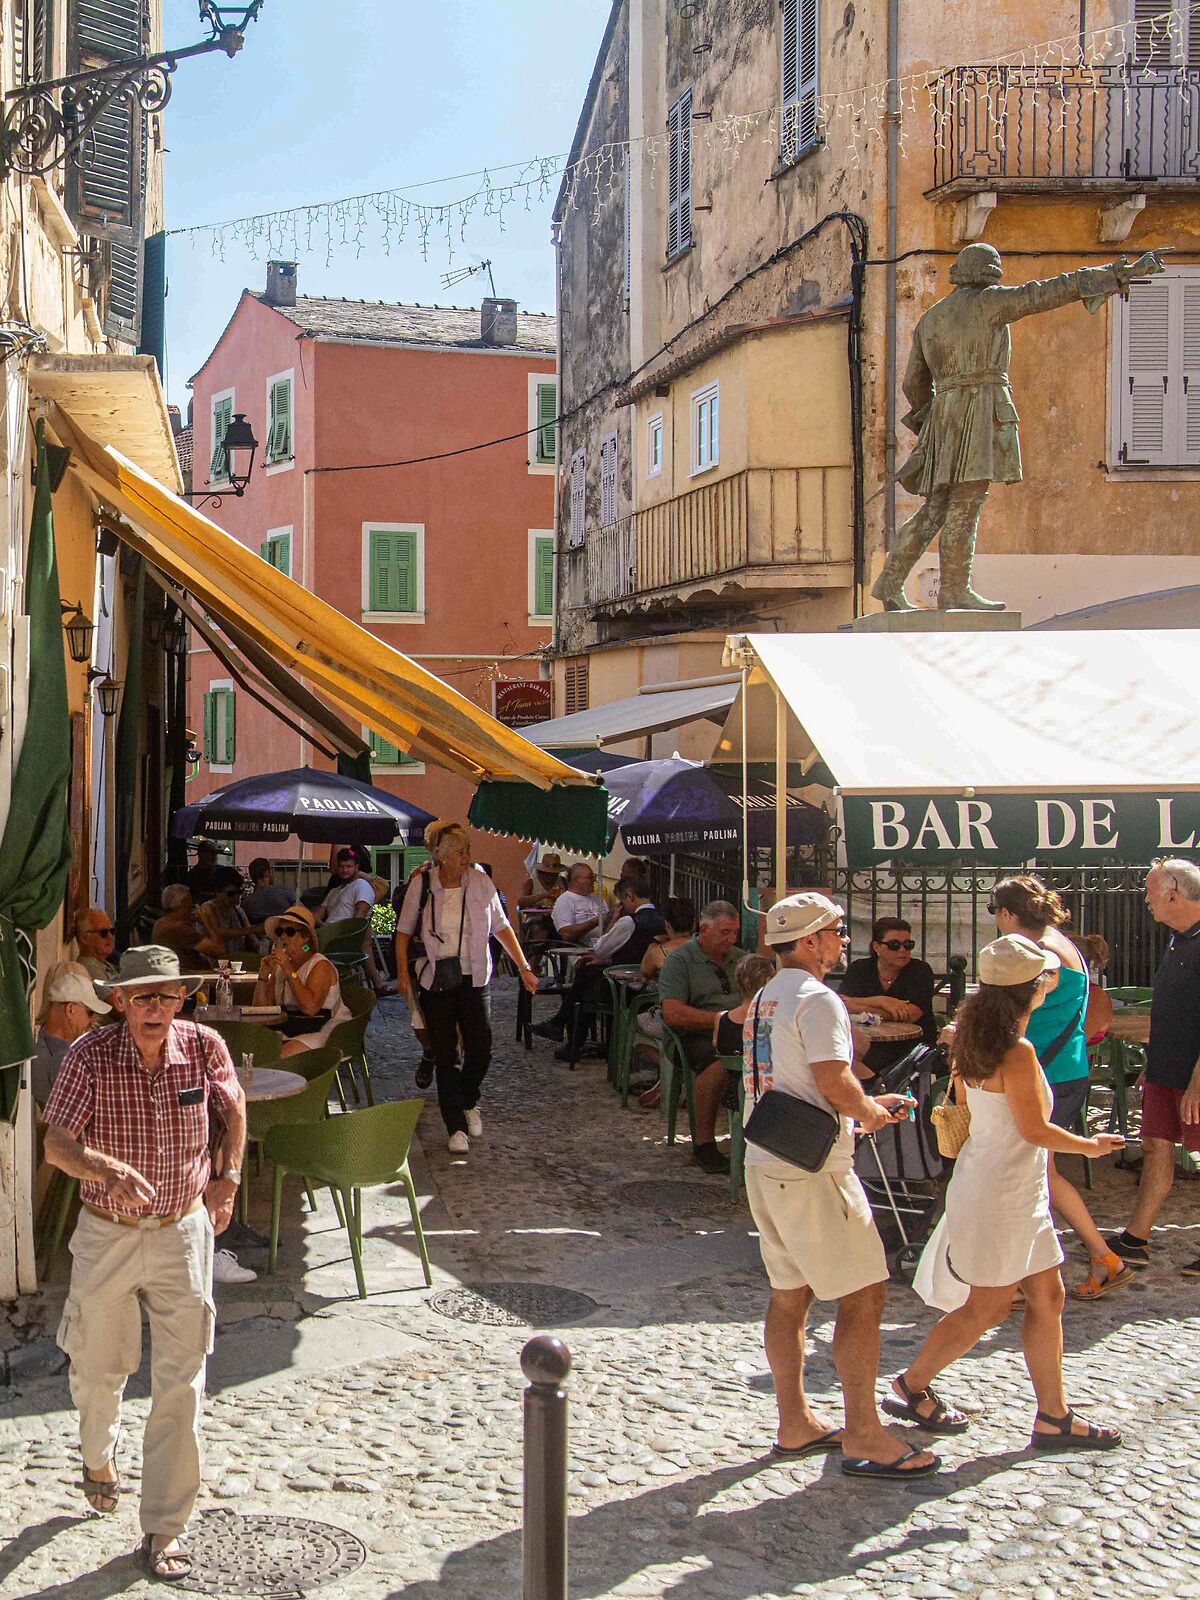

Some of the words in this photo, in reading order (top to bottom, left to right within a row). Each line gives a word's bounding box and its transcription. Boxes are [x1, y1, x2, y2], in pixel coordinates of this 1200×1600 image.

[300, 797, 379, 812] PAOLINA
[205, 822, 232, 831] PAOLINA
[262, 824, 289, 832] PAOLINA
[869, 800, 998, 850] BAR
[1034, 800, 1120, 850] DE
[1156, 798, 1200, 848] L
[627, 834, 660, 845] PAOLINA
[665, 832, 698, 843] PAOLINA
[703, 829, 738, 840] PAOLINA
